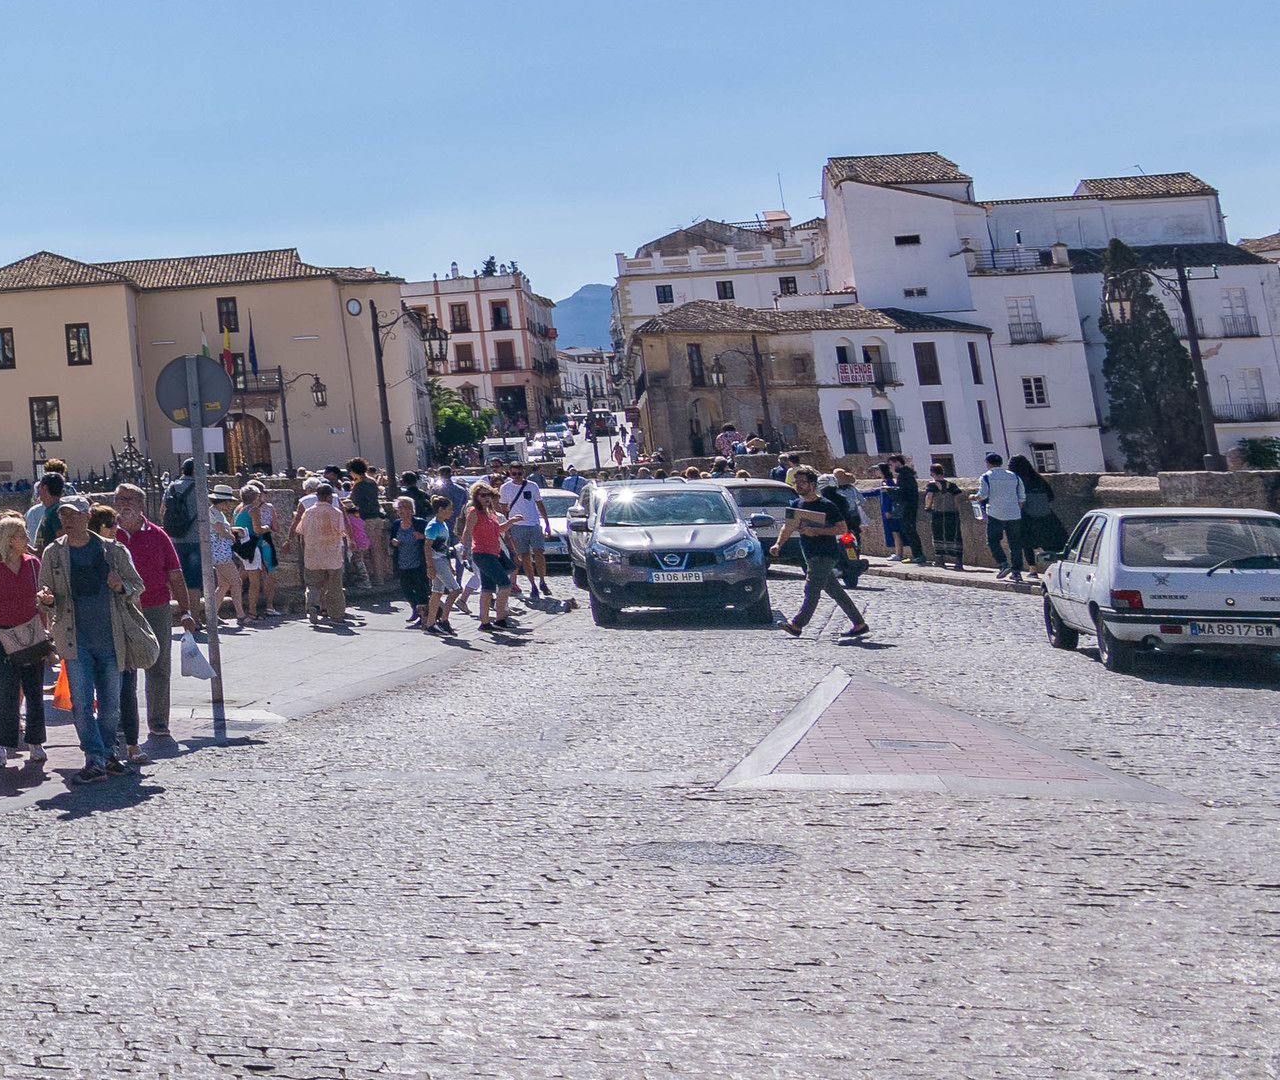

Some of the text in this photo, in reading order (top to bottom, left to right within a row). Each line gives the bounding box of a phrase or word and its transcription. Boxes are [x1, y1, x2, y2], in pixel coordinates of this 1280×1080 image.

[840, 363, 872, 374] SE VENDE
[654, 573, 700, 581] 9106 HPB
[1197, 624, 1273, 636] MA 8917 BW
